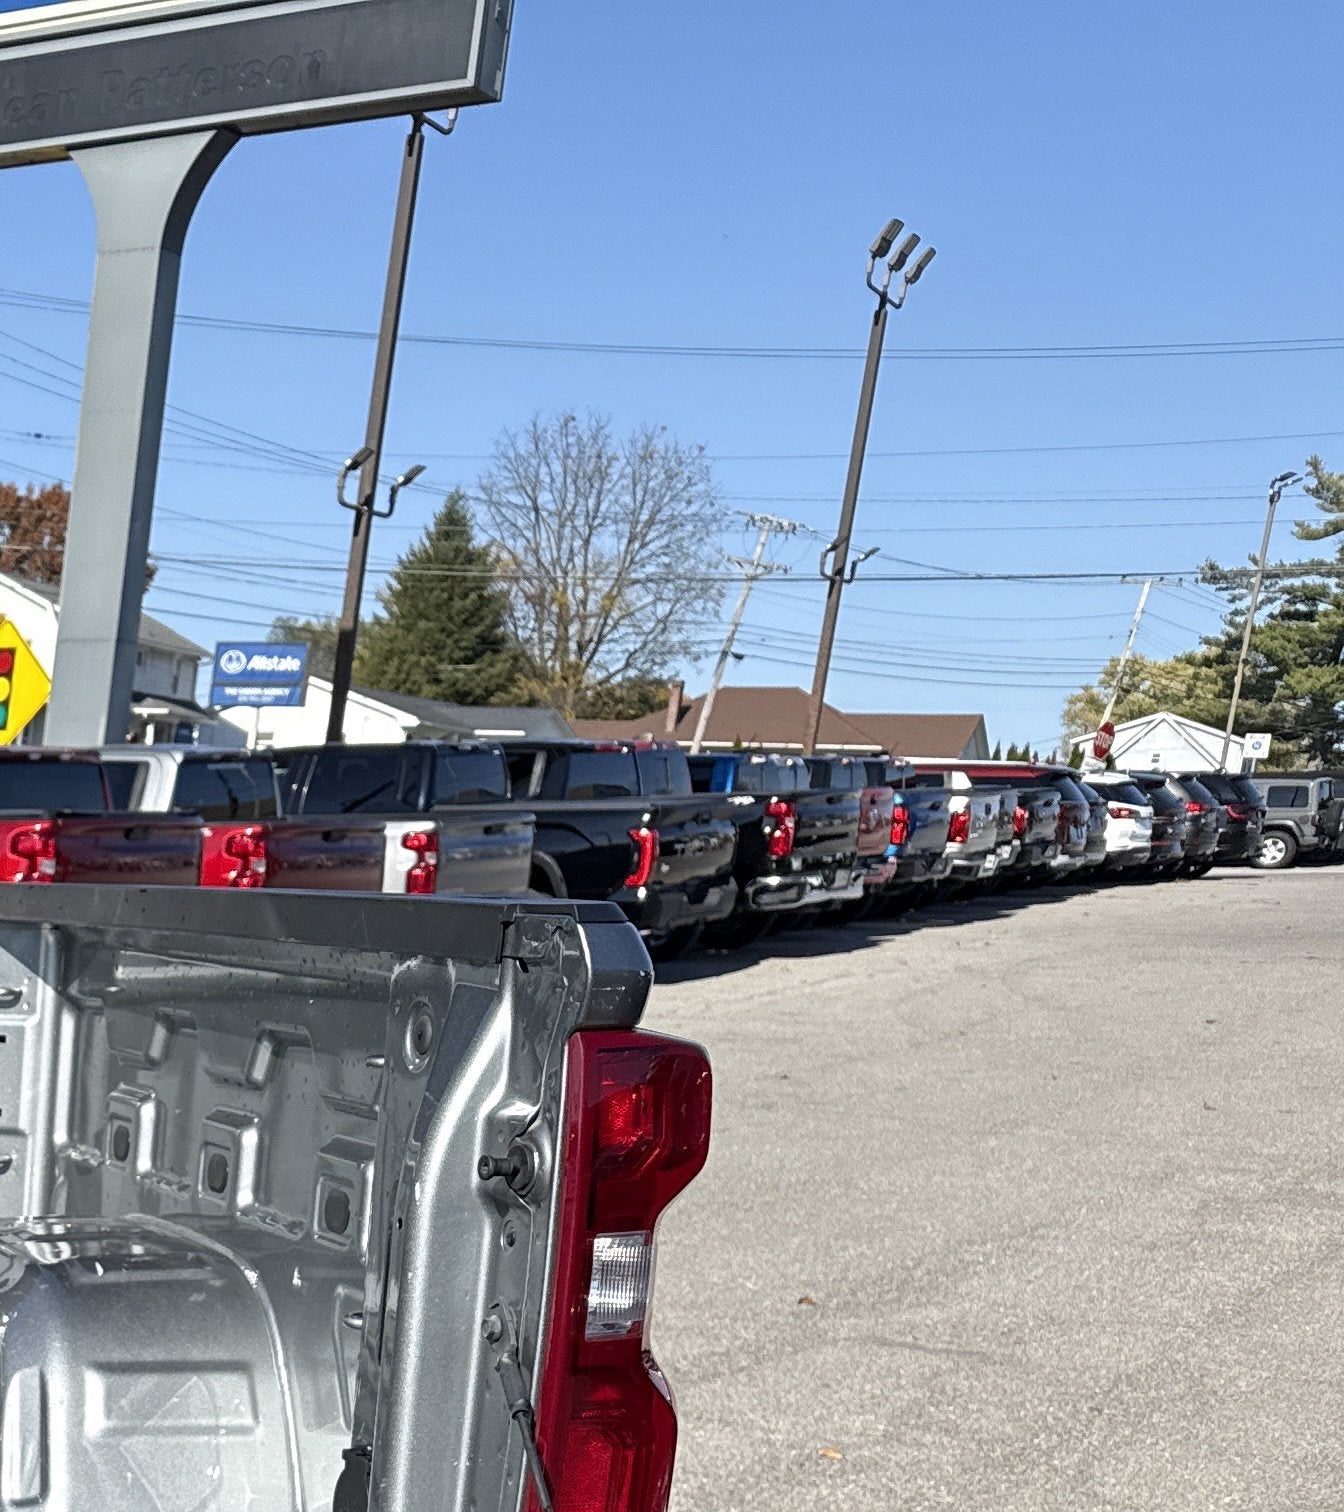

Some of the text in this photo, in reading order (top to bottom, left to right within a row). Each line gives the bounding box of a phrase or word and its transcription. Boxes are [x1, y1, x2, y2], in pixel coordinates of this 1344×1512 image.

[99, 49, 328, 115] Patterson
[246, 655, 301, 671] Allstate
[1094, 730, 1114, 749] STOP
